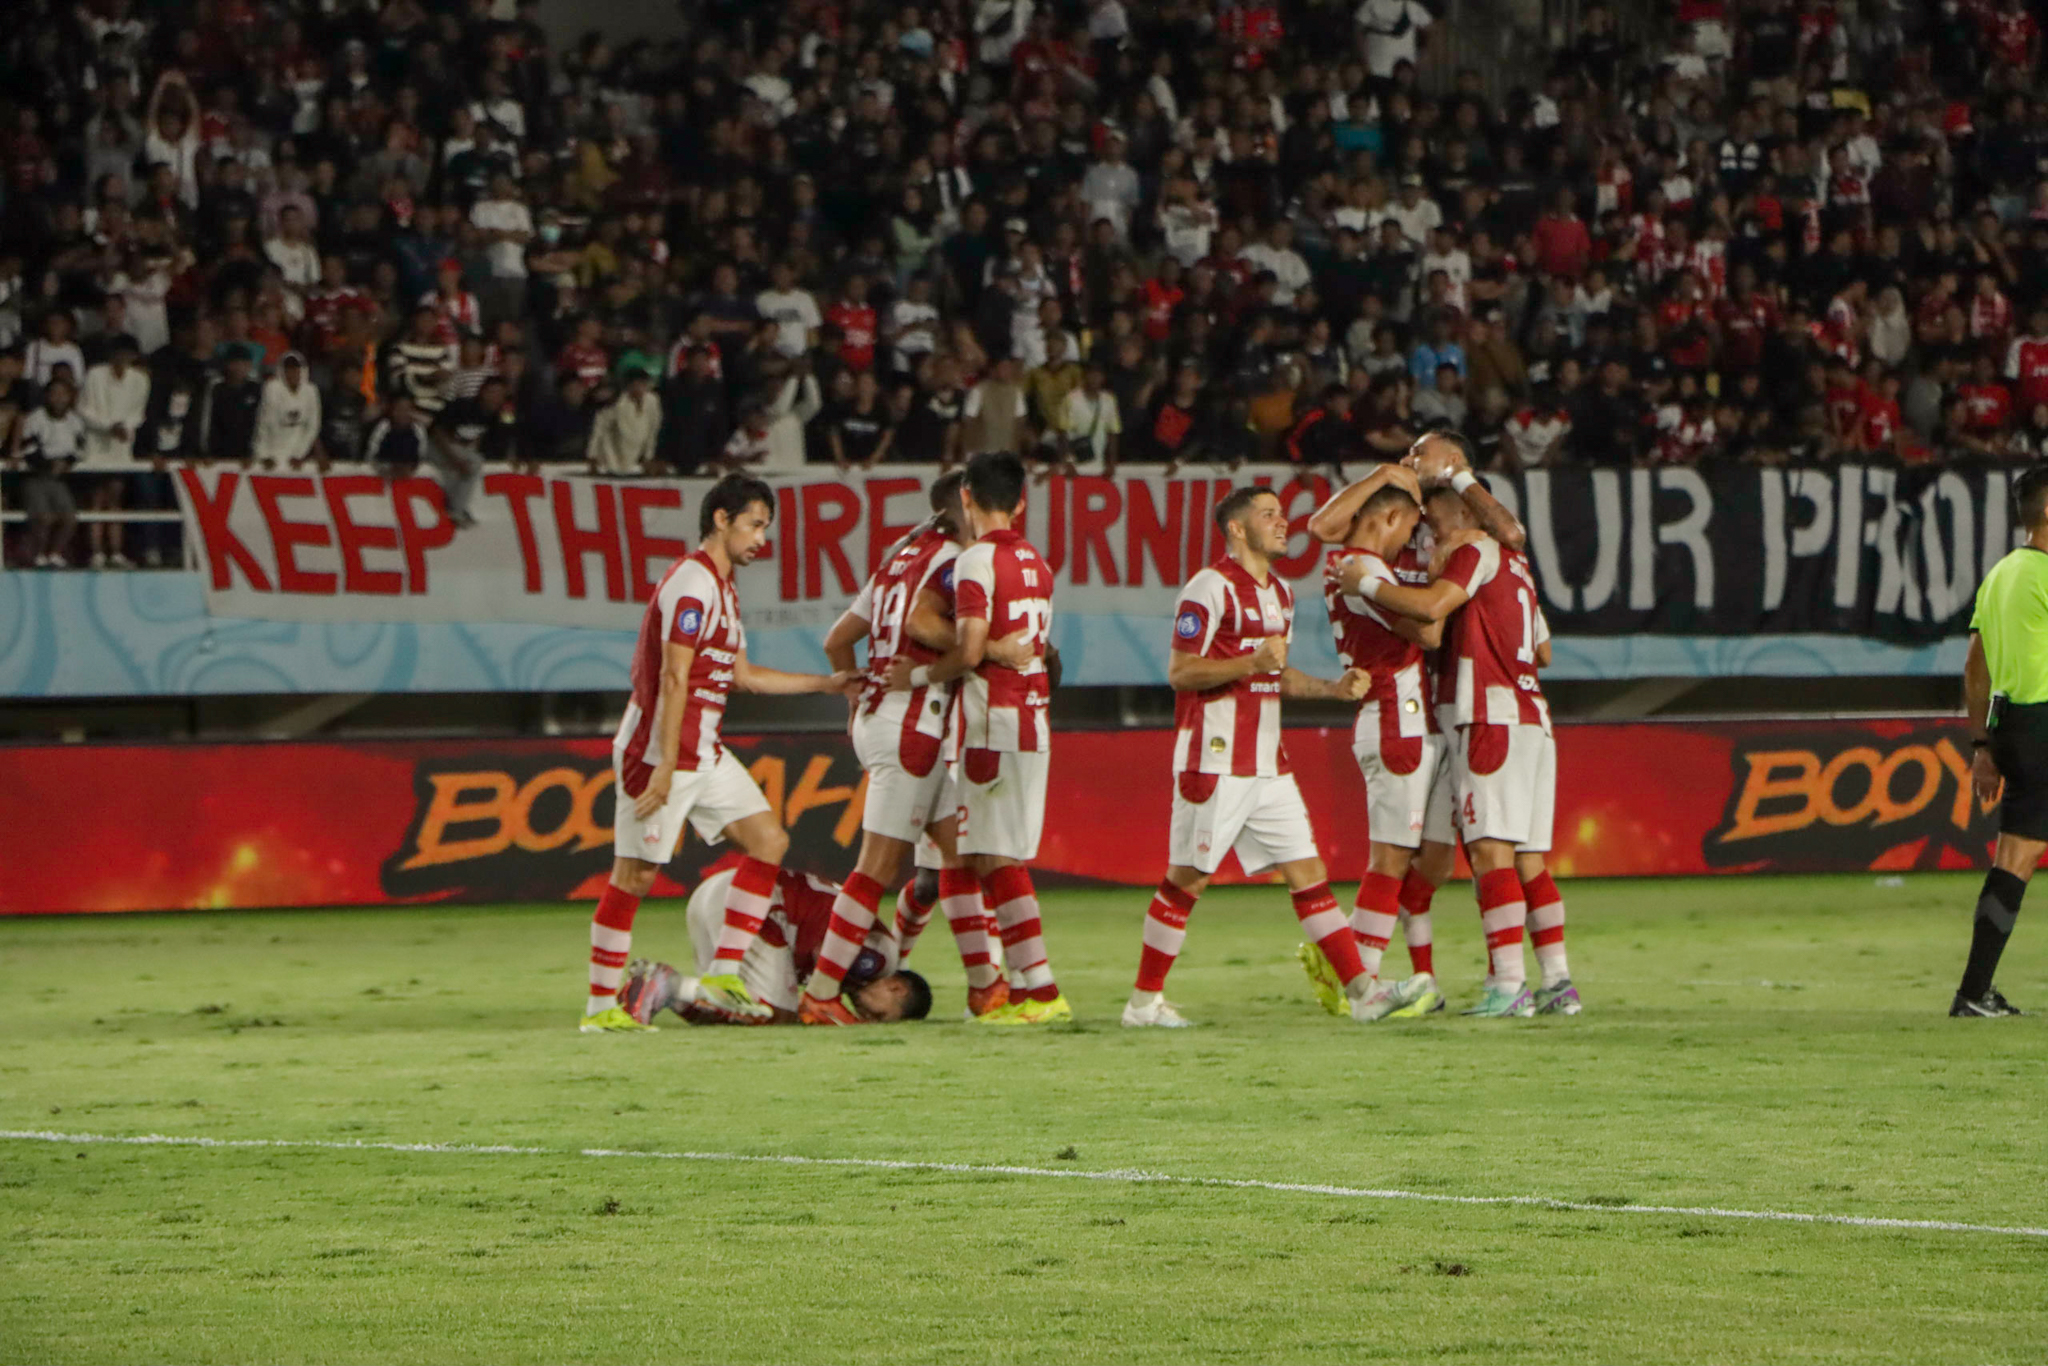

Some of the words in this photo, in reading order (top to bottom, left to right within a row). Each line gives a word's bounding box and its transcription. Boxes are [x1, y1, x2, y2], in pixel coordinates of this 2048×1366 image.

[178, 468, 456, 595] KEEP
[484, 474, 685, 603] THE
[754, 478, 922, 602] IRE
[1010, 473, 1332, 589] URNIG
[1476, 466, 1714, 613] UR
[869, 581, 907, 659] 19
[397, 754, 870, 871] BOAH
[1718, 737, 2005, 842] BOOY
